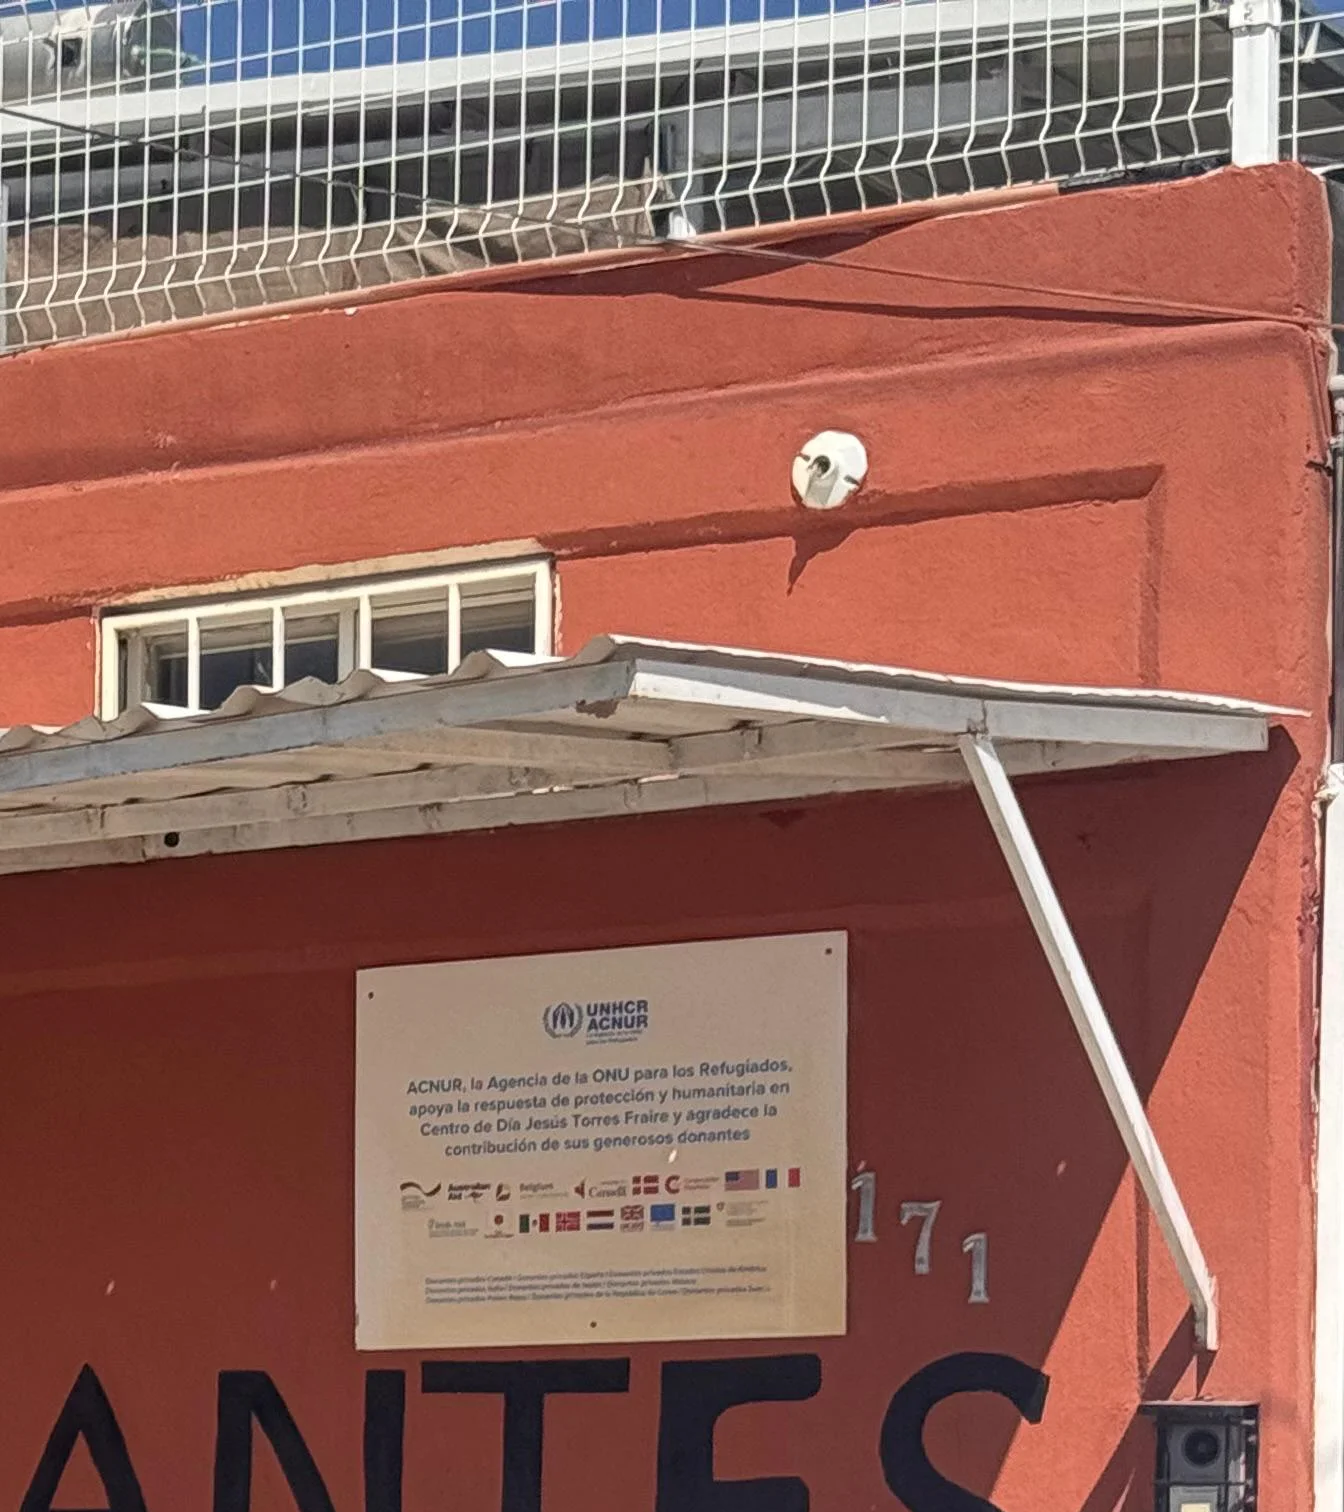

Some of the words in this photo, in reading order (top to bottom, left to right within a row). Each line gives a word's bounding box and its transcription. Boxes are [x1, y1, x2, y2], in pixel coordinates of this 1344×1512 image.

[585, 999, 650, 1017] UNHCR
[586, 1014, 650, 1033] ACNUR
[406, 1078, 467, 1095] ACNUR,
[470, 1077, 483, 1091] la
[487, 1073, 548, 1093] Agencia
[551, 1072, 571, 1086] de
[575, 1071, 589, 1085] la
[592, 1067, 630, 1083] ONU
[633, 1068, 669, 1084] para
[672, 1065, 695, 1078] los
[409, 1102, 454, 1119] apoya
[457, 1100, 470, 1114] la
[474, 1095, 547, 1115] respuesta
[550, 1093, 570, 1107] de
[573, 1089, 655, 1109] protección
[658, 1090, 668, 1104] y
[672, 1081, 766, 1101] humanitaria
[769, 1081, 791, 1095] en
[419, 1121, 470, 1137] Centro
[473, 1120, 493, 1134] de
[496, 1116, 522, 1133] Día
[525, 1115, 569, 1131] Jesús
[572, 1113, 621, 1129] Torres
[624, 1109, 670, 1125] Fraire
[672, 1110, 683, 1126] y
[685, 1104, 760, 1125] agradece
[763, 1103, 779, 1117] la
[444, 1136, 537, 1157] contribución
[540, 1136, 561, 1152] de
[563, 1135, 590, 1149] sus
[593, 1131, 675, 1152] generosos
[677, 1127, 751, 1145] donantes
[850, 1170, 991, 1304] 171
